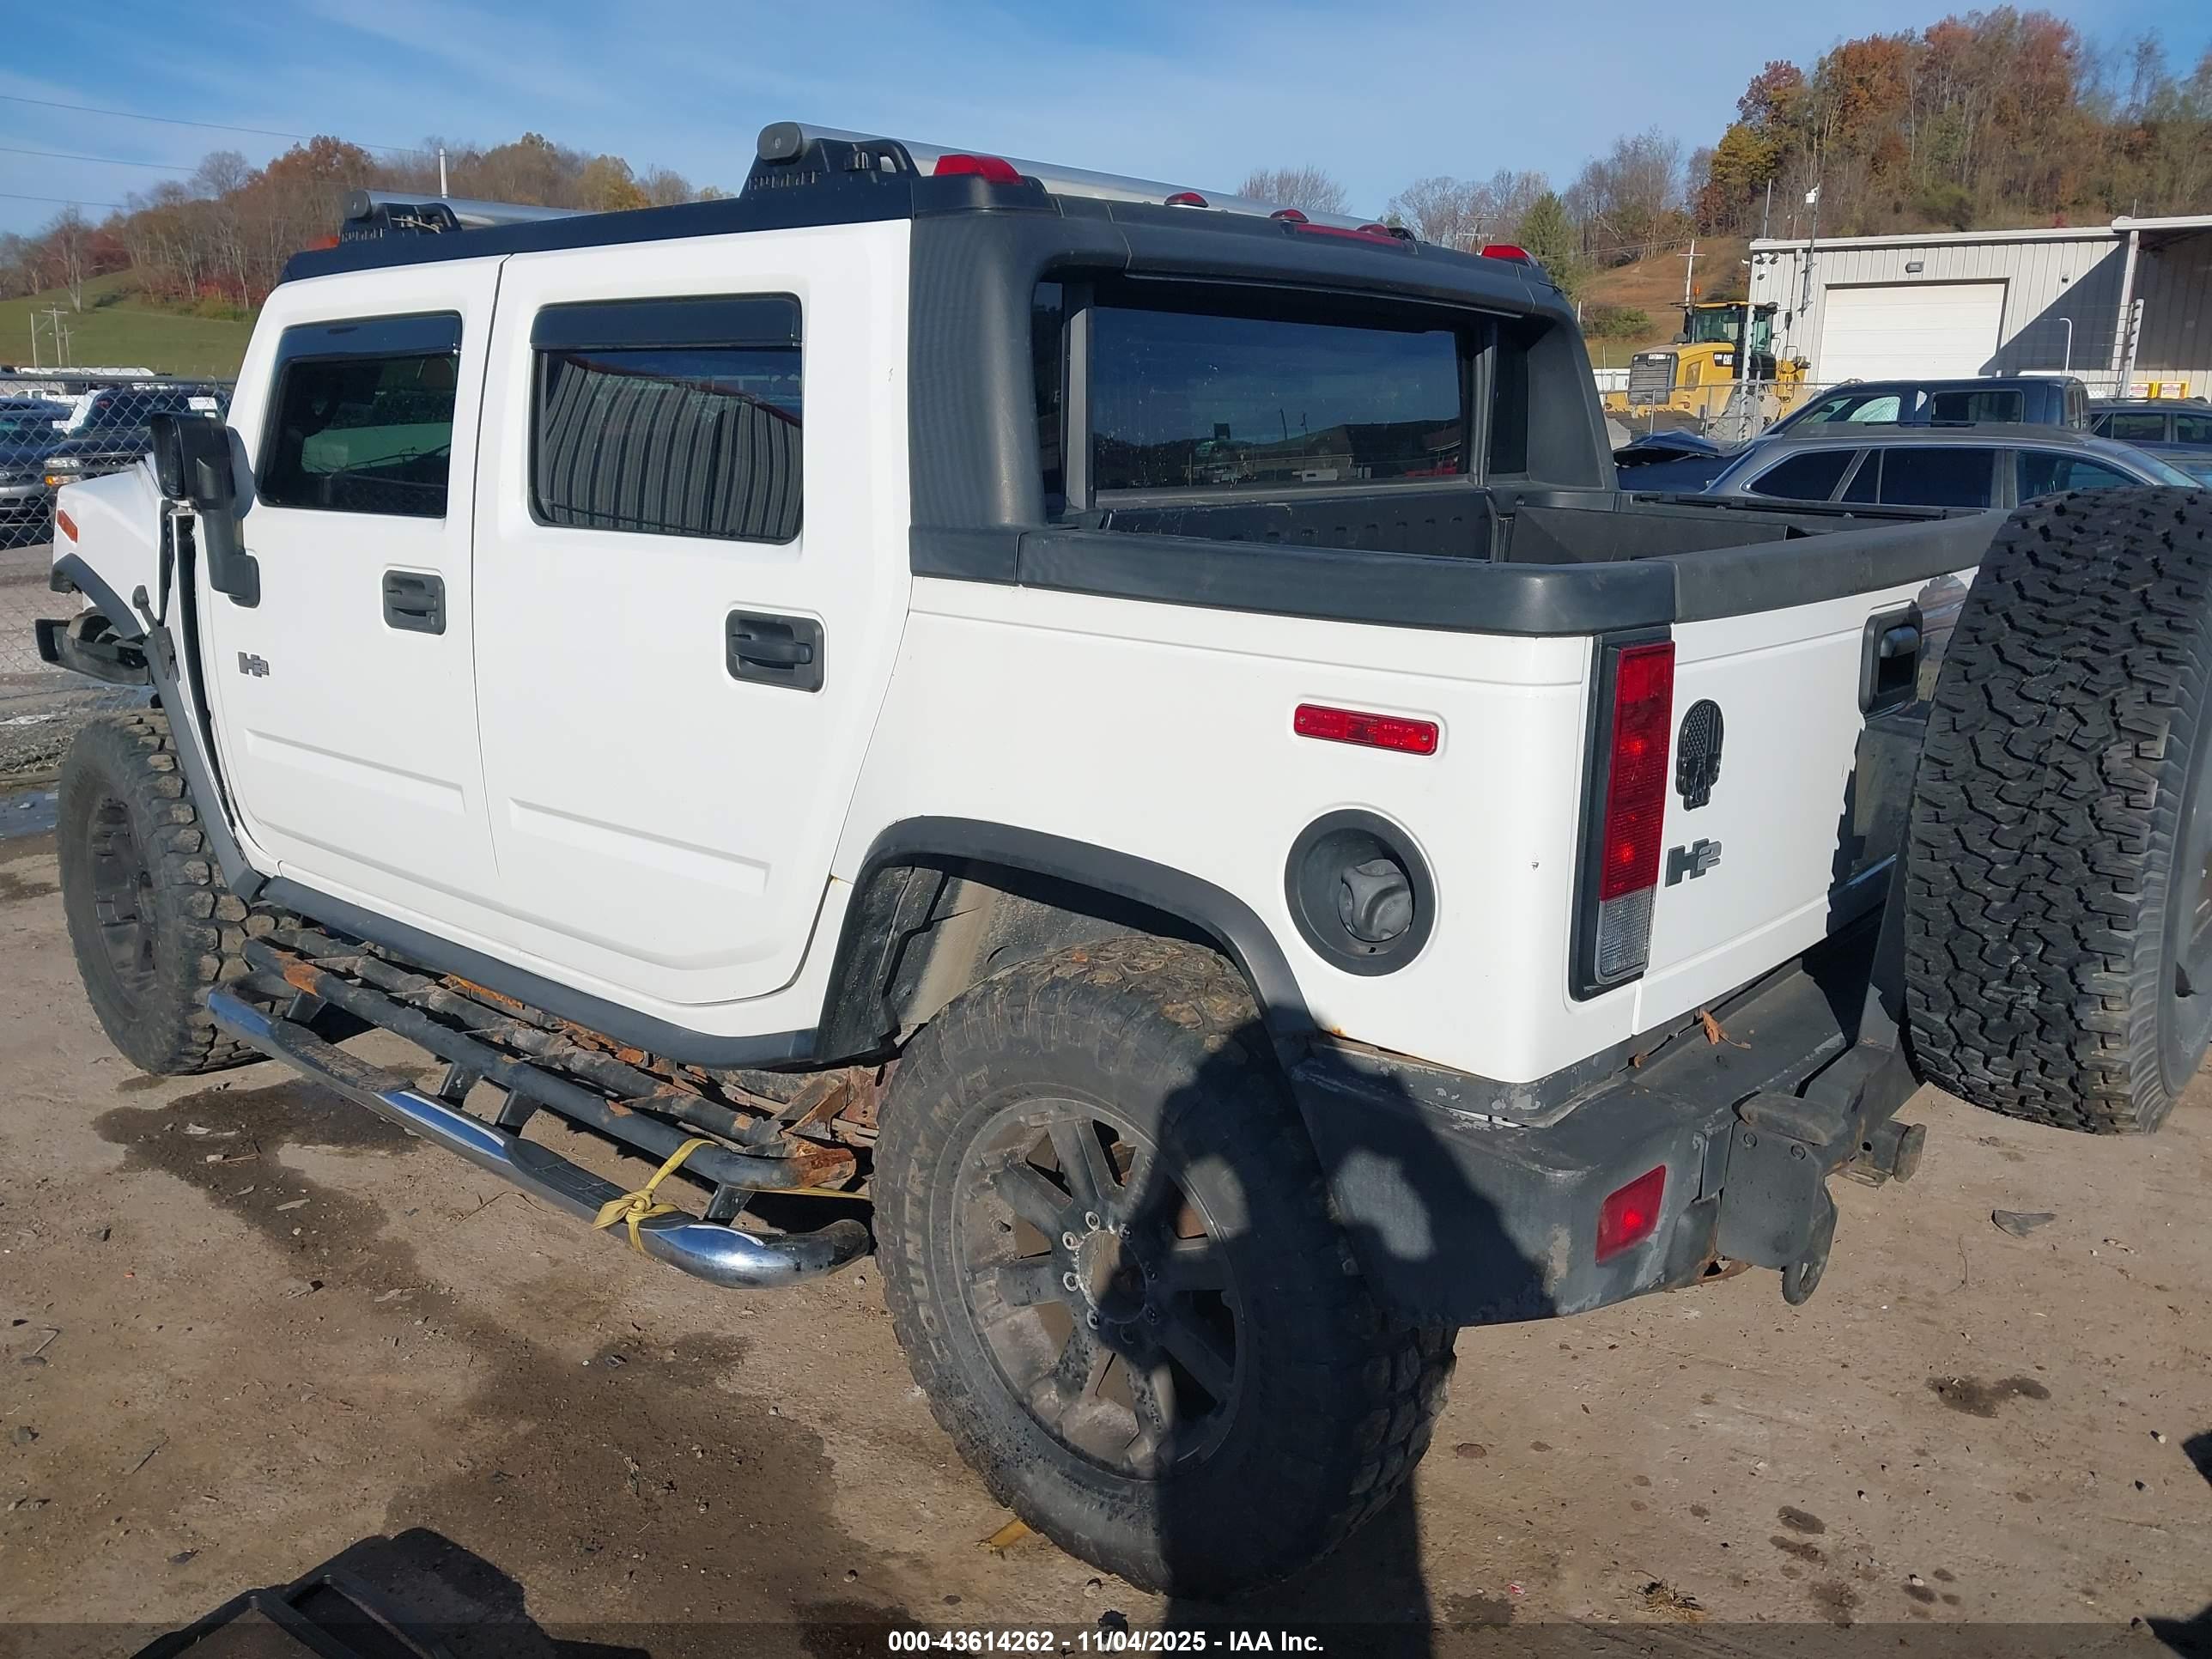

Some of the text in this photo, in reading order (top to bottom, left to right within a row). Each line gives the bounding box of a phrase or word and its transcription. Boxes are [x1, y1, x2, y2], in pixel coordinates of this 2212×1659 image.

[1723, 354, 1733, 365] CAT
[238, 652, 270, 678] H2
[1665, 838, 1722, 887] H2
